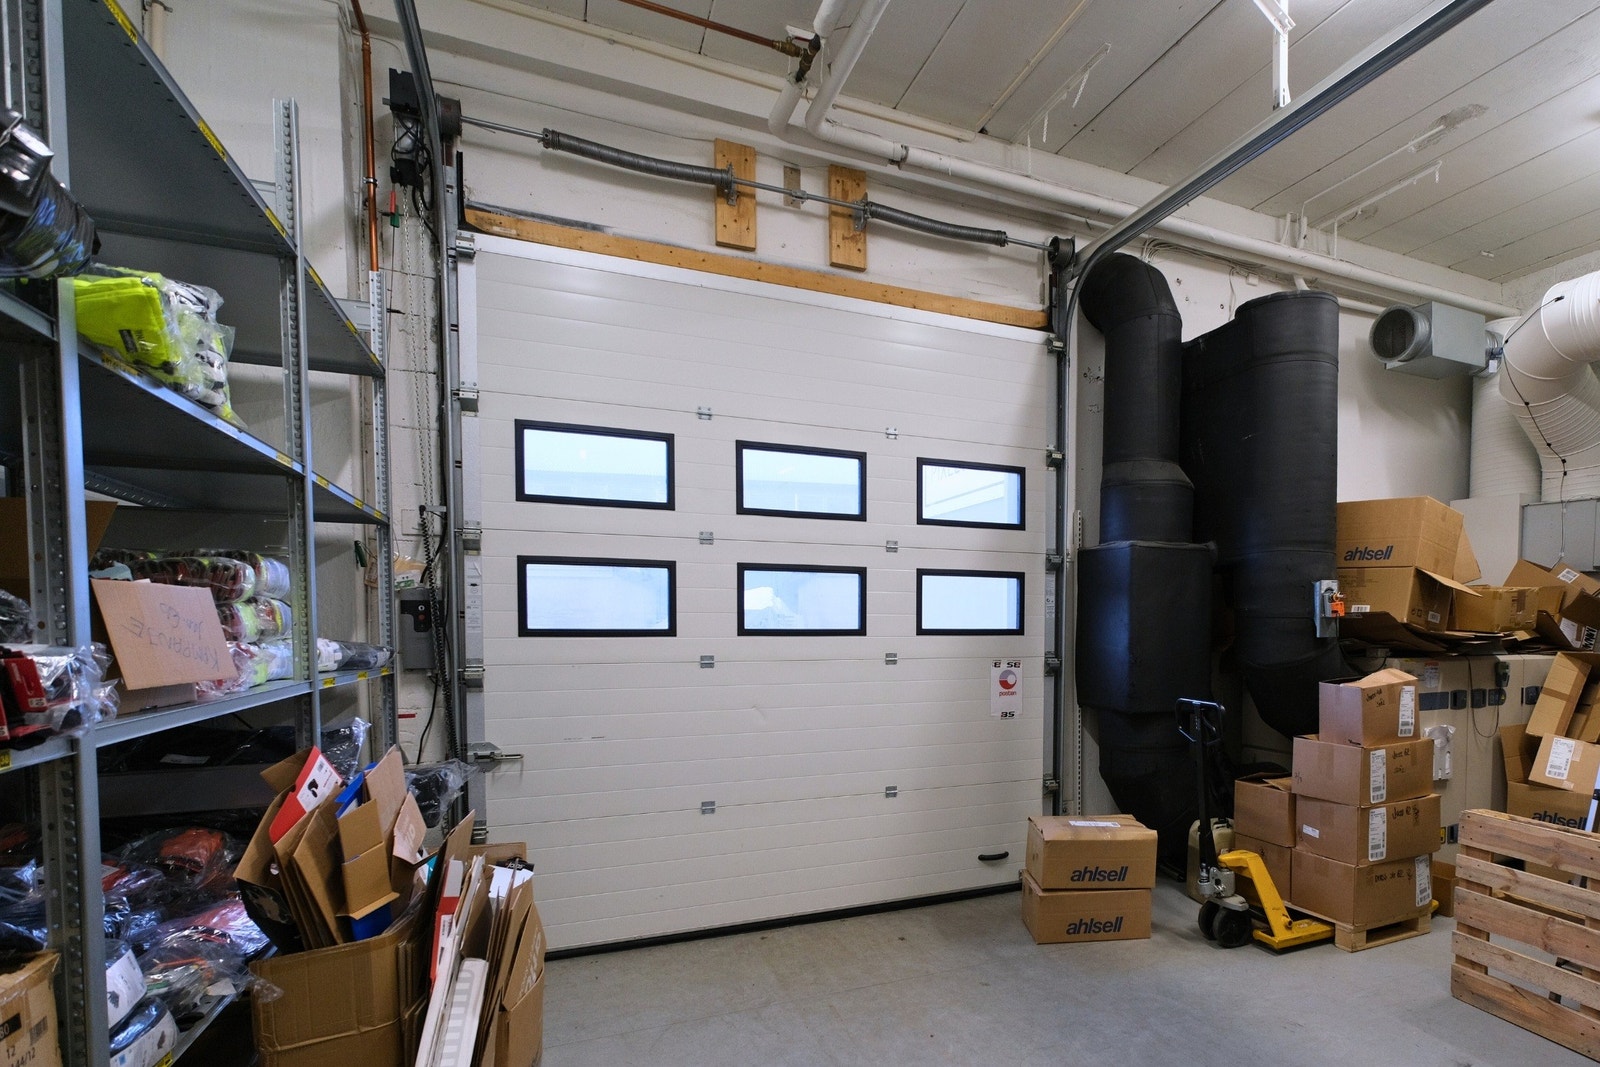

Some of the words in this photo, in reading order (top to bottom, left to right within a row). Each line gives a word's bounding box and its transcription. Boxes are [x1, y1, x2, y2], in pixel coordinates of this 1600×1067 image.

[1343, 545, 1394, 562] ahlsell
[1531, 810, 1588, 830] ahlsell
[1070, 866, 1128, 882] ahlsell
[1066, 916, 1123, 935] ahlsell
